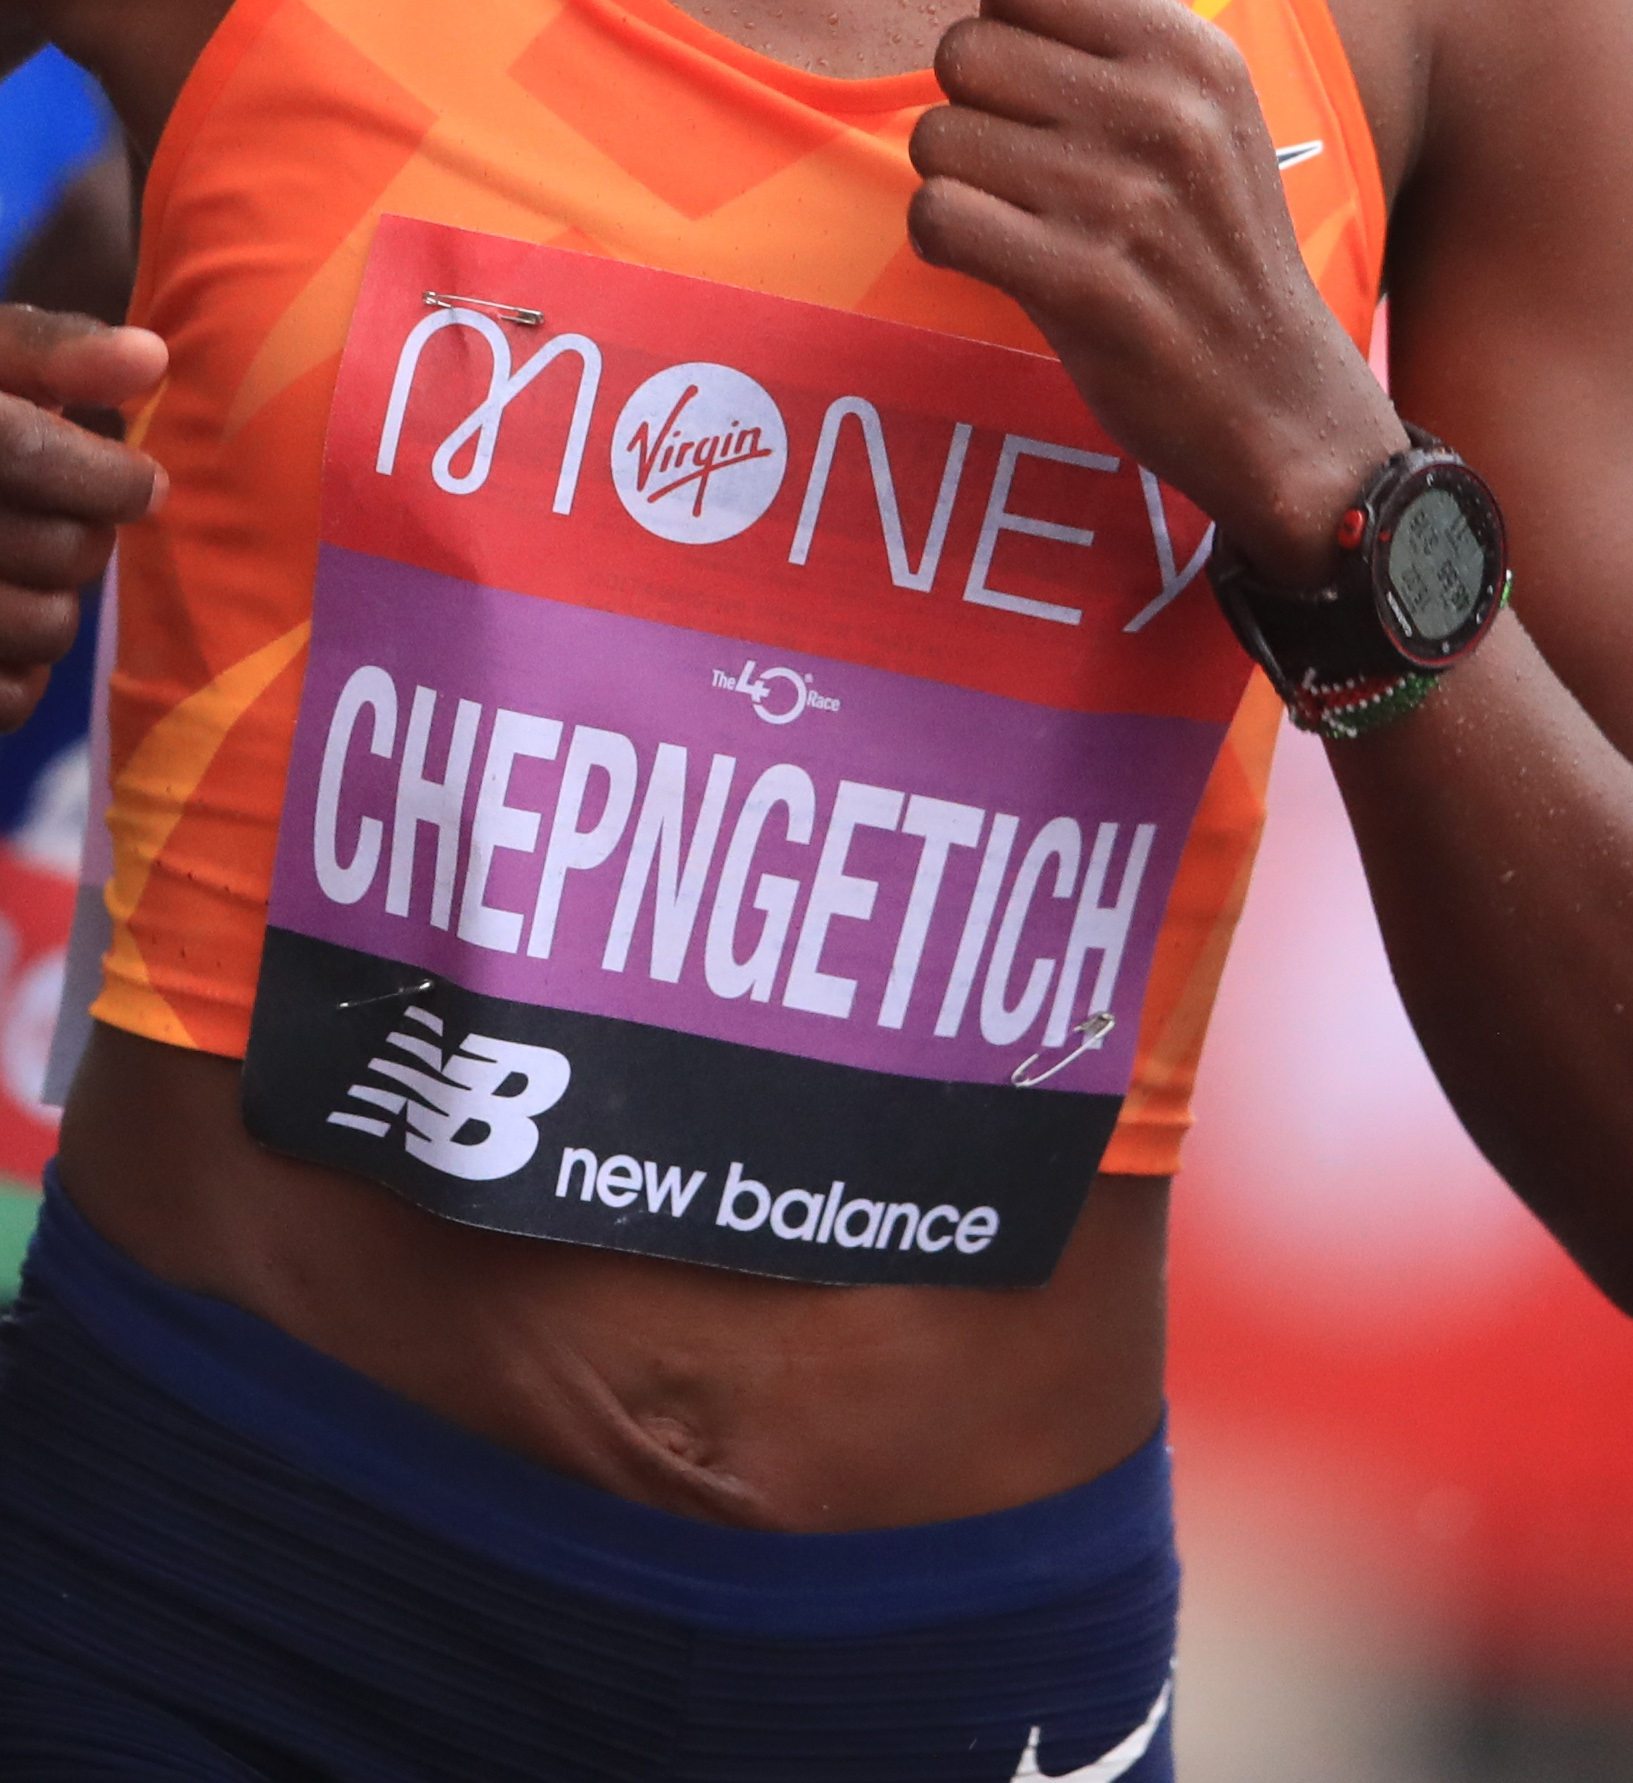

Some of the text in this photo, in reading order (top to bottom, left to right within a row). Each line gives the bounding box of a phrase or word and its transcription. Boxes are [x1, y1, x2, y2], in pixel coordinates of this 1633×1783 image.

[625, 384, 773, 517] Virgin
[711, 669, 736, 691] The
[807, 690, 840, 712] Race
[311, 664, 1157, 1051] CHEPNGETICH
[555, 1146, 1000, 1255] new balance
